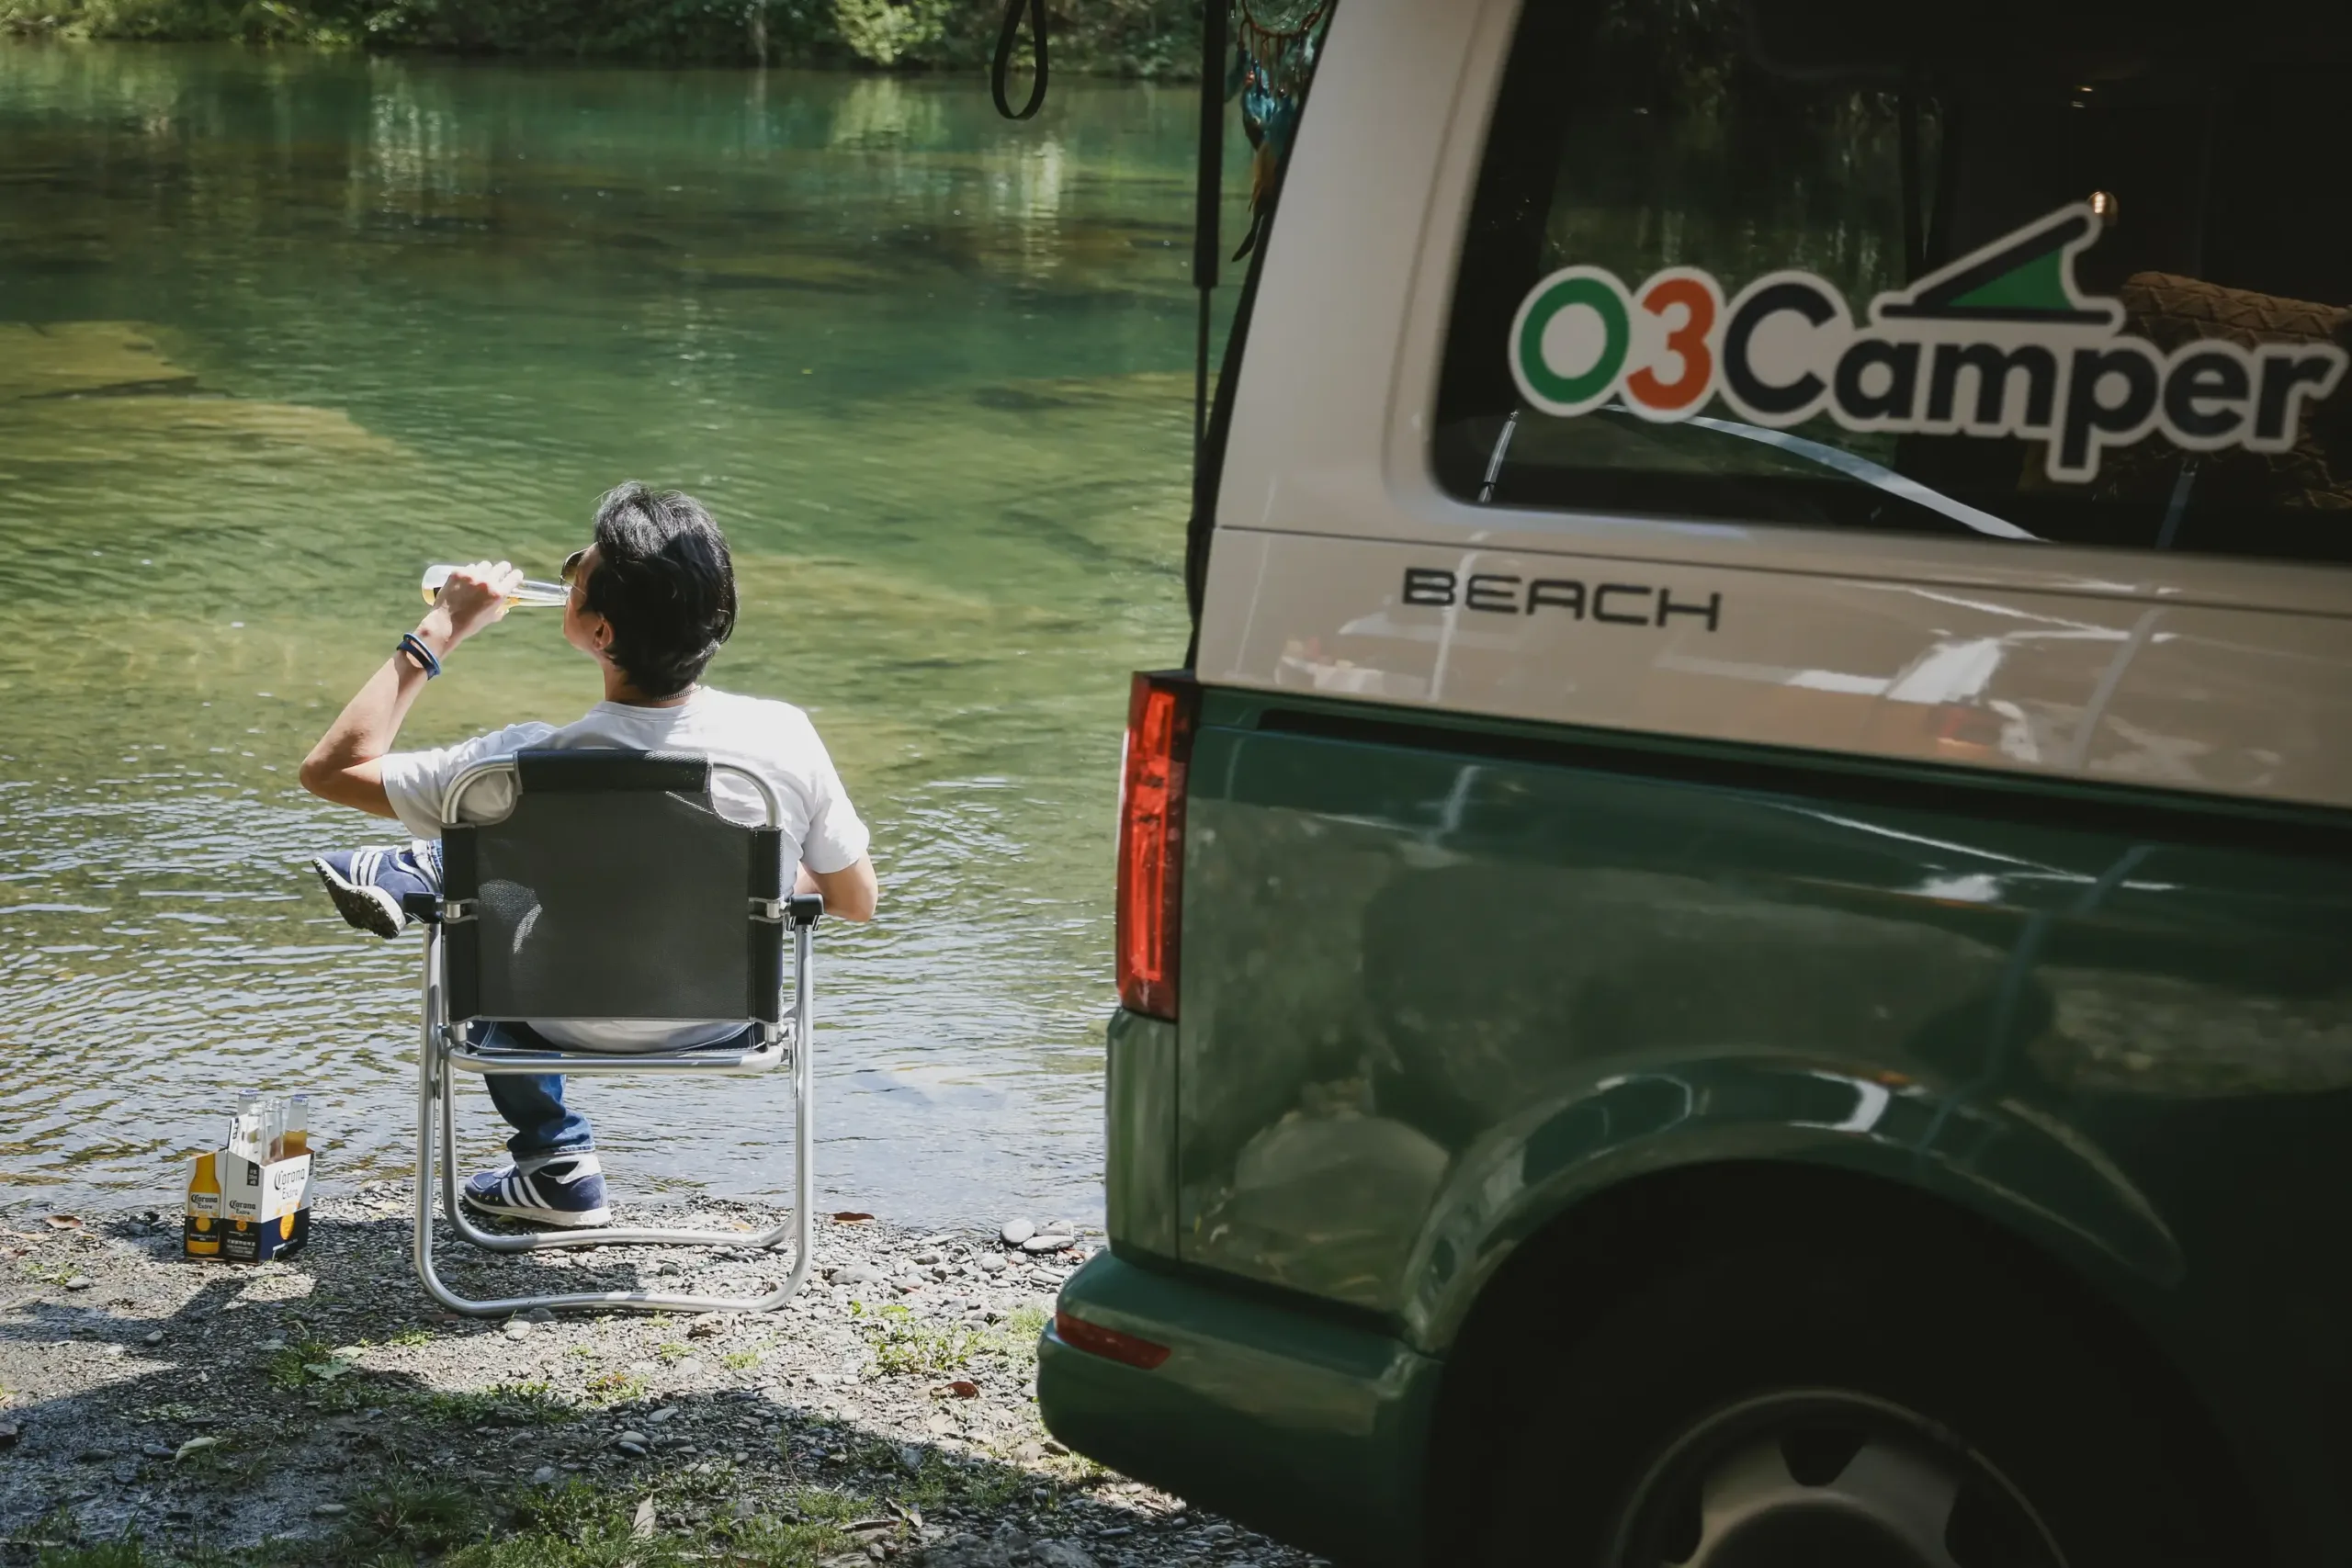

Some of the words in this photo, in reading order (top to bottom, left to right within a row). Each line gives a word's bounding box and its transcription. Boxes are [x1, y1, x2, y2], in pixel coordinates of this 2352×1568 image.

[1511, 268, 2343, 478] O3Camper
[1402, 568, 1722, 632] BEACH
[274, 1168, 305, 1190] Corona
[190, 1194, 218, 1203] Corona
[229, 1200, 256, 1210] Corona
[235, 1207, 251, 1215] Extra
